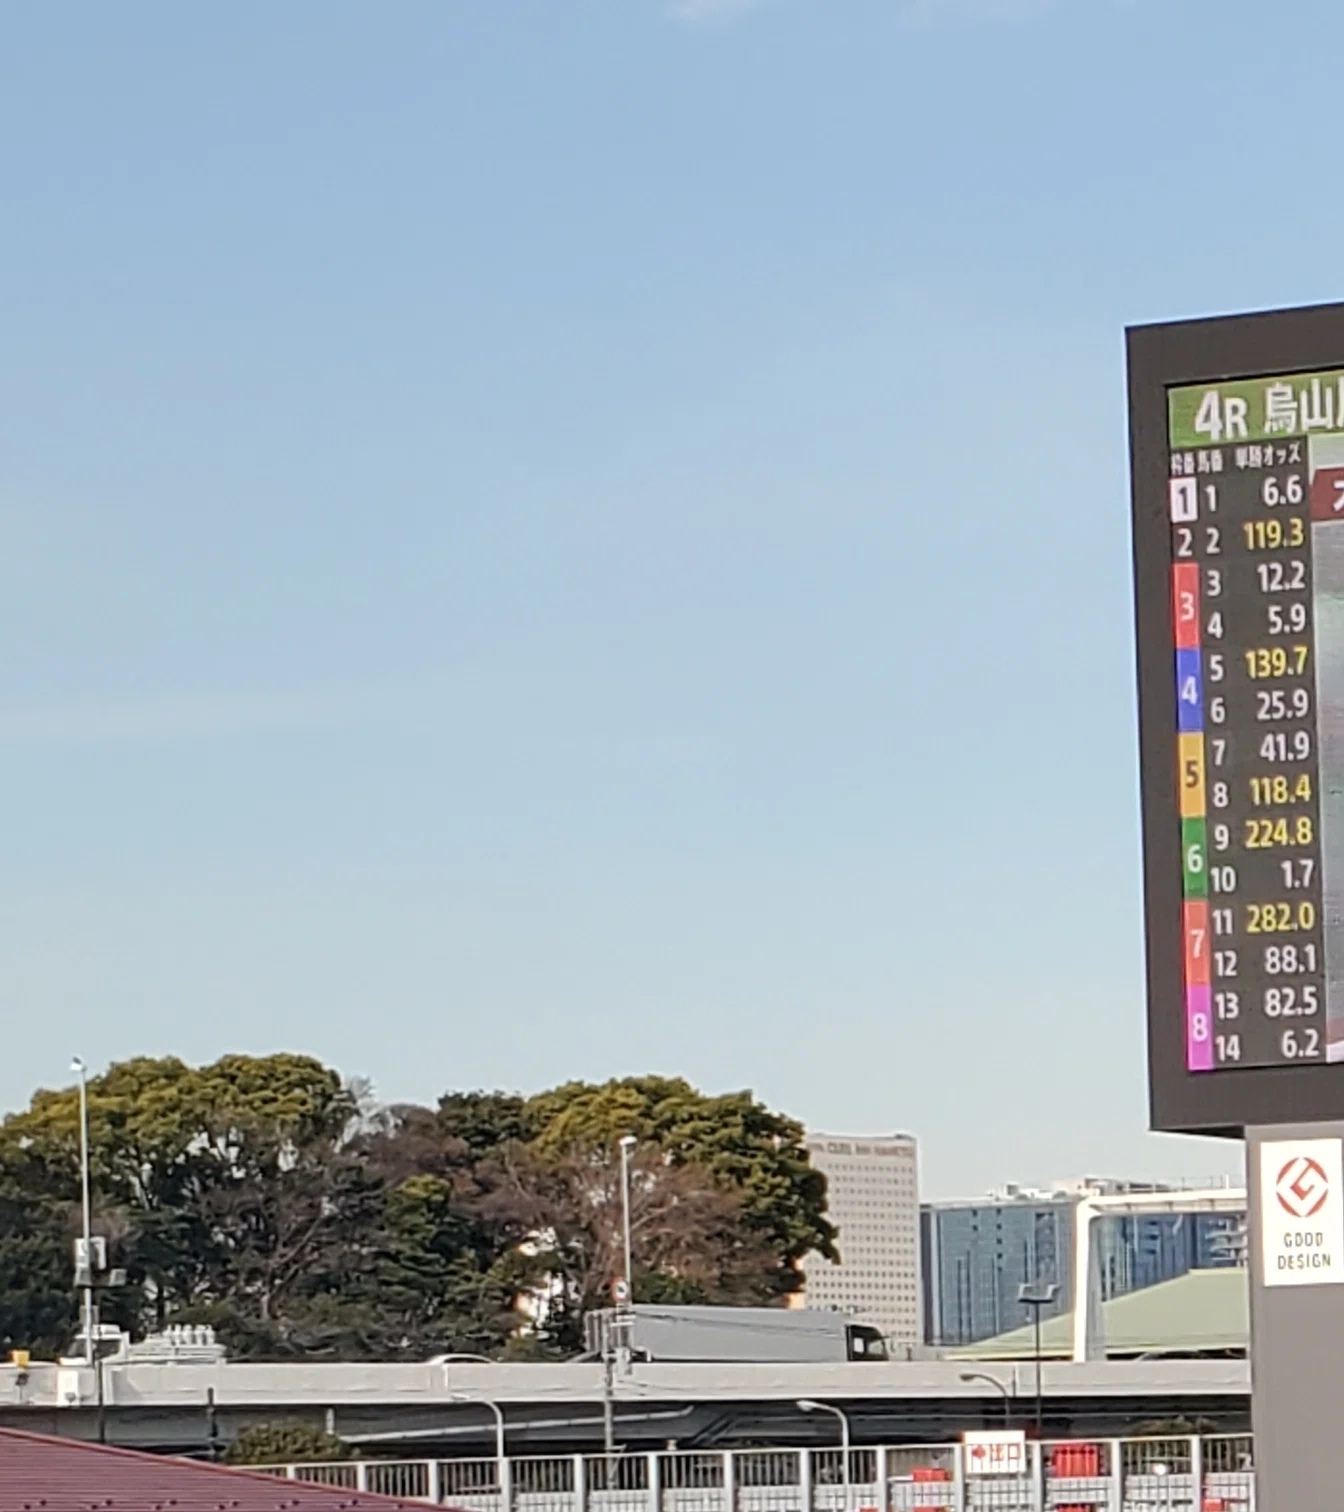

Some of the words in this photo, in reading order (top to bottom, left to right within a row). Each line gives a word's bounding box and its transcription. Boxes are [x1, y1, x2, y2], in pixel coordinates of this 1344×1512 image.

[1195, 389, 1249, 442] 4R
[1178, 484, 1191, 520] 1
[1204, 484, 1217, 512] 1
[1263, 474, 1303, 507] 6.6
[1178, 527, 1193, 557] 2
[1206, 527, 1221, 555] 2
[1243, 517, 1305, 550] 119.3
[1207, 569, 1222, 597] 3
[1257, 560, 1306, 593] 12.2
[1179, 591, 1195, 622] 3
[1207, 612, 1224, 640] 4
[1268, 603, 1307, 635] 5.9
[1210, 654, 1224, 682] 5
[1245, 645, 1309, 680] 139.7
[1181, 675, 1199, 705] 4
[1211, 696, 1226, 724] 6
[1256, 687, 1309, 721] 25.9
[1213, 739, 1227, 767] 7
[1259, 731, 1311, 763] 41.9
[1185, 760, 1199, 788] 5
[1213, 782, 1230, 809] 8
[1249, 774, 1312, 806] 118.4
[1215, 824, 1230, 851] 9
[1245, 816, 1313, 850] 224.8
[1187, 844, 1203, 874] 6
[1210, 866, 1237, 893] 10
[1281, 858, 1315, 889] 1.7
[1212, 908, 1233, 936] 11
[1246, 902, 1315, 935] 282.0
[1190, 928, 1206, 959] 7
[1214, 950, 1238, 979] 12
[1264, 943, 1318, 974] 88.1
[1215, 992, 1240, 1020] 13
[1263, 985, 1318, 1017] 82.5
[1192, 1012, 1208, 1042] 8
[1215, 1034, 1241, 1062] 14
[1281, 1028, 1320, 1059] 6.2
[1283, 1232, 1324, 1248] GOOD
[1277, 1253, 1332, 1270] DESIGN
